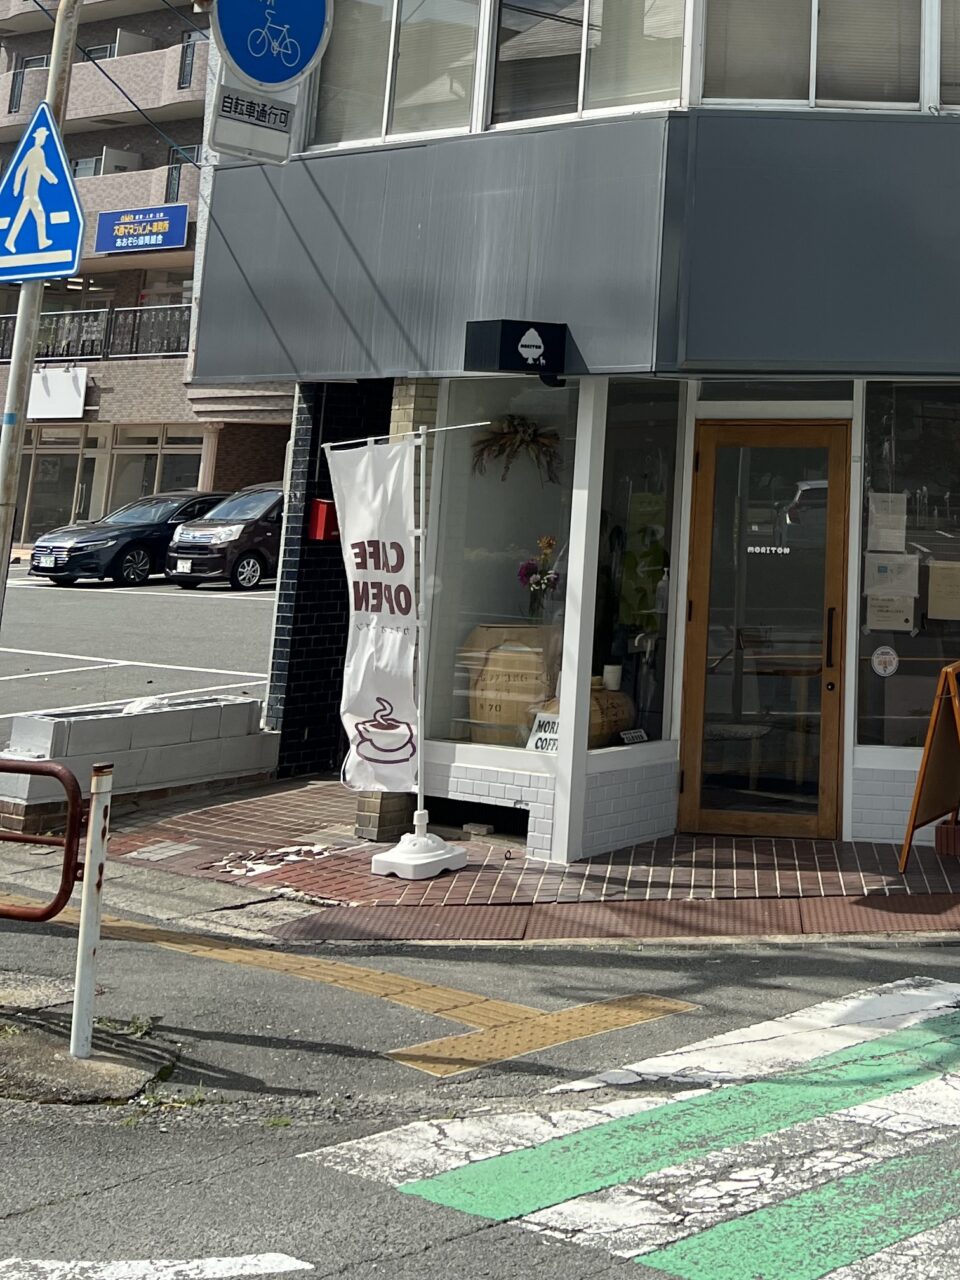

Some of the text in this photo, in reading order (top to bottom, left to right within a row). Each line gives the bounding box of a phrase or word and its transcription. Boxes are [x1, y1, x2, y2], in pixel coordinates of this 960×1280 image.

[222, 94, 290, 128] 自転車通行可
[747, 546, 790, 554] MORITON
[534, 737, 559, 751] COFF
